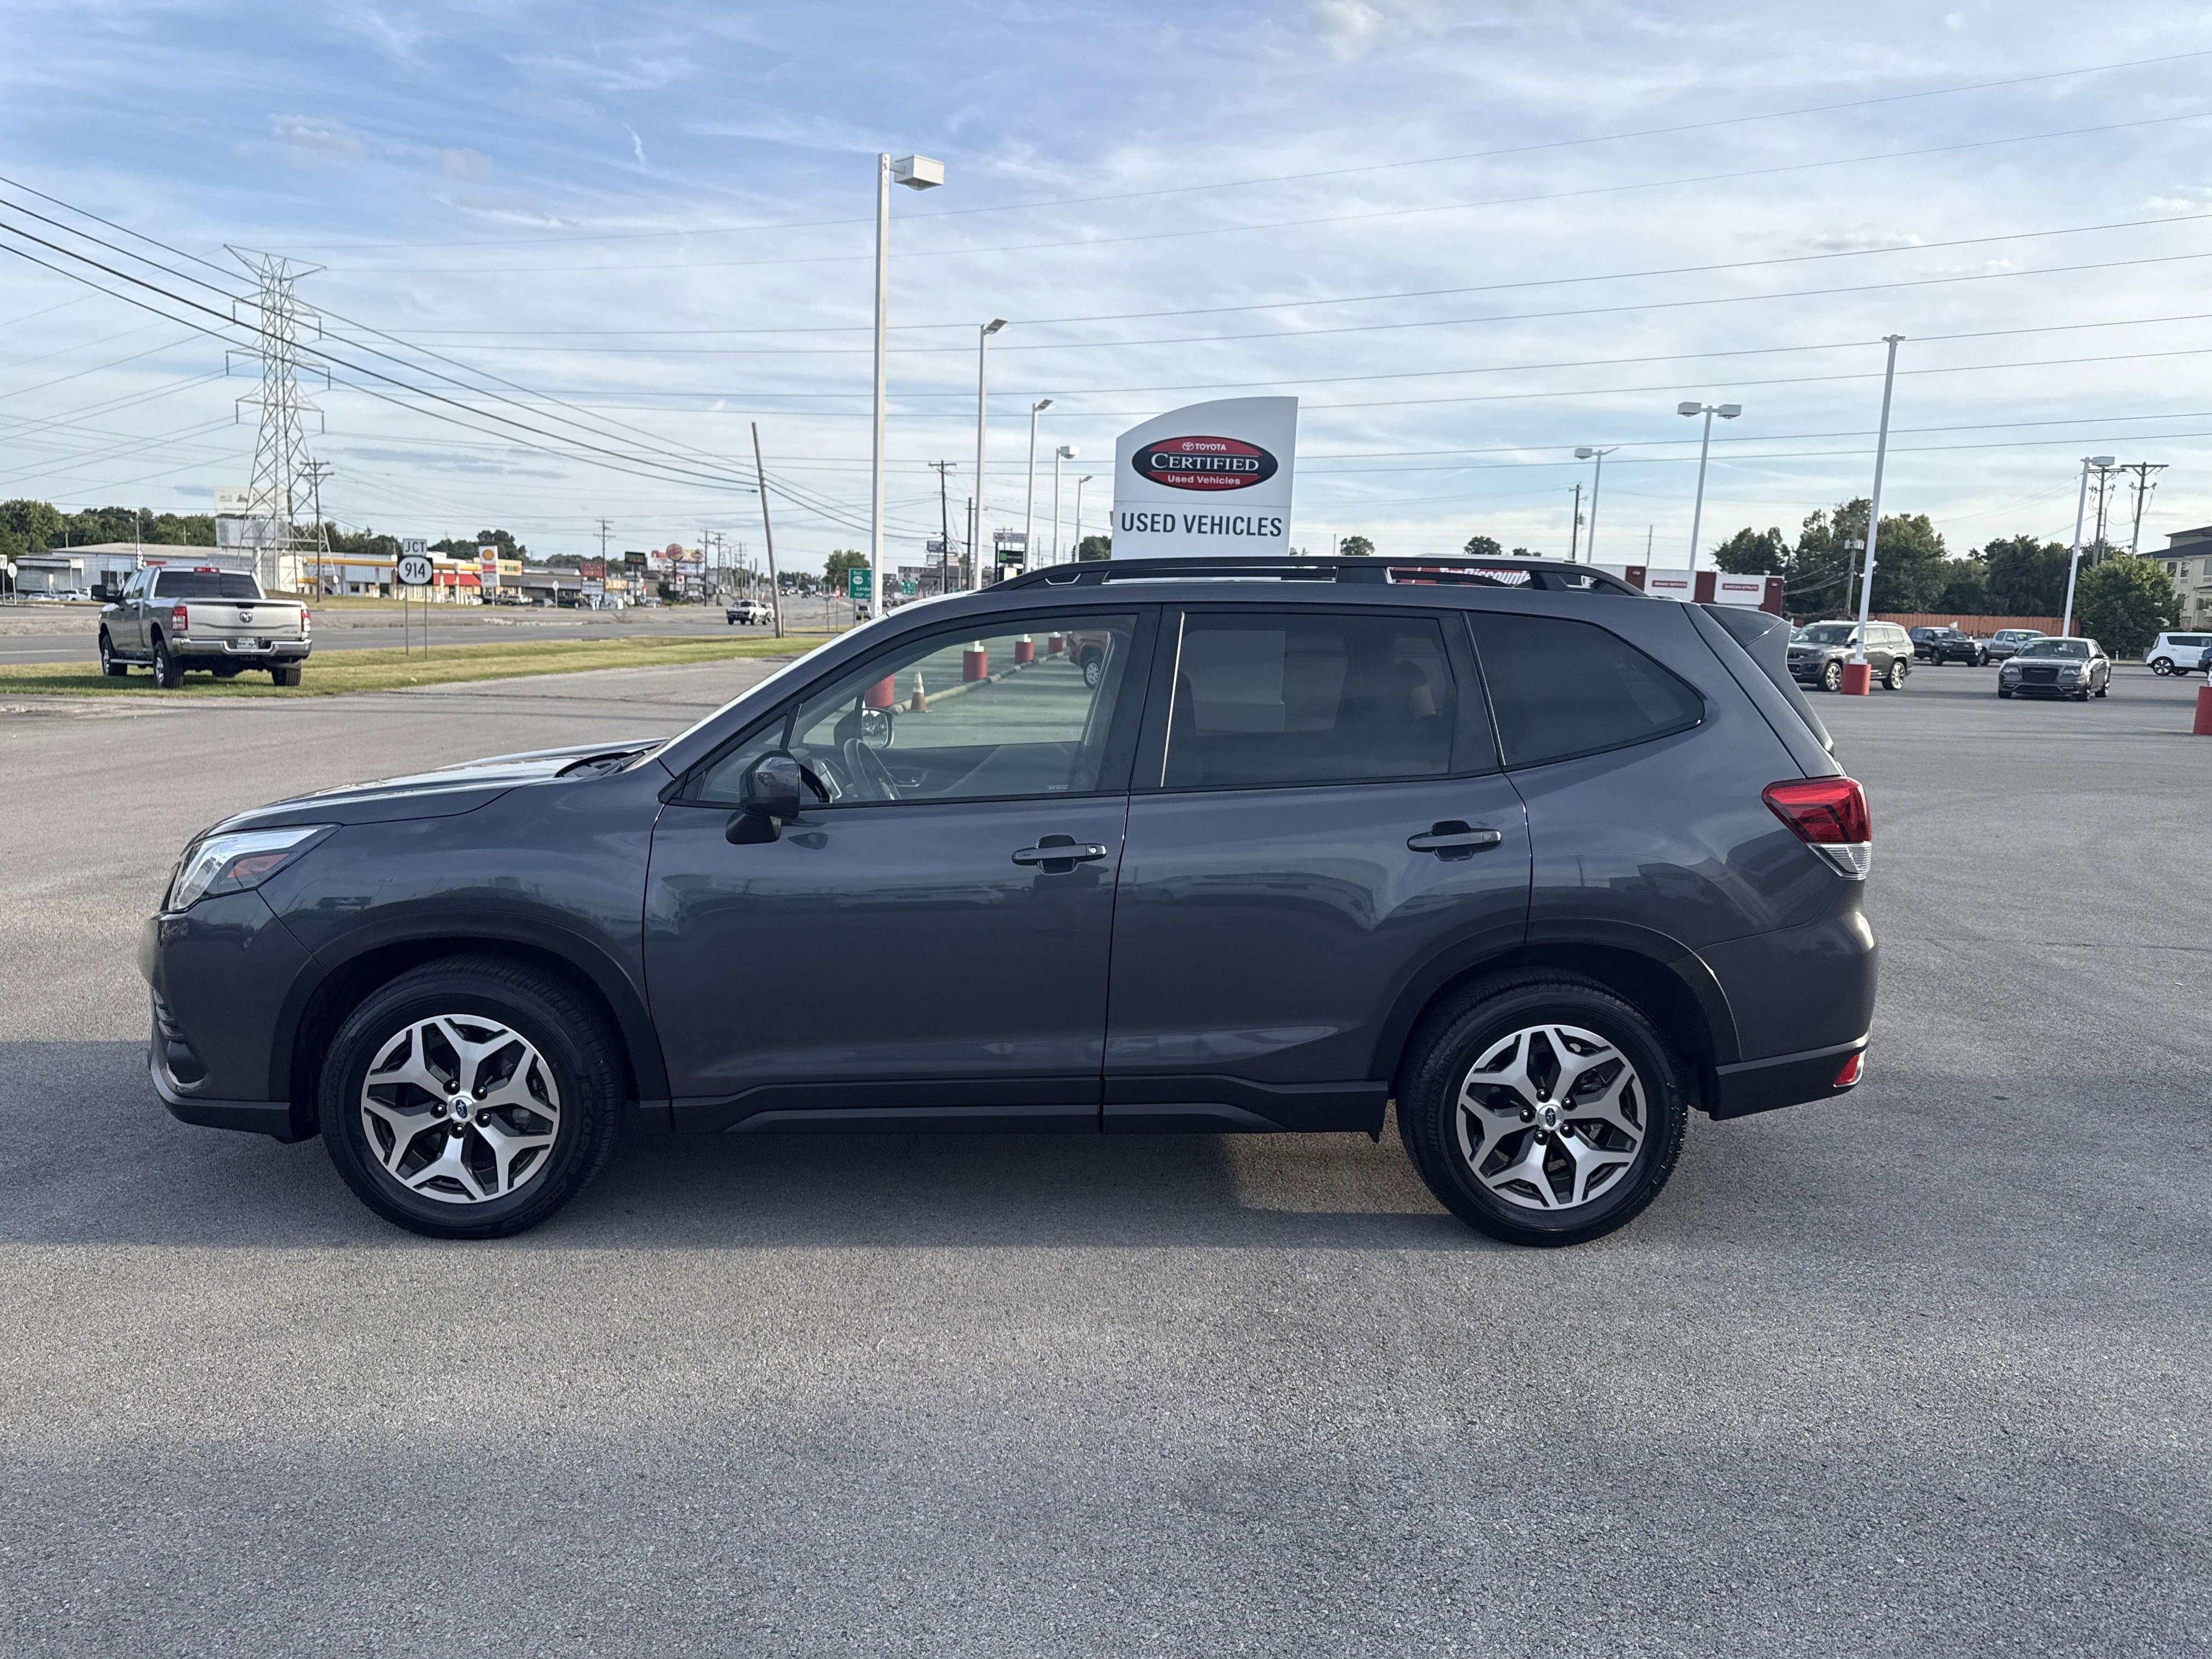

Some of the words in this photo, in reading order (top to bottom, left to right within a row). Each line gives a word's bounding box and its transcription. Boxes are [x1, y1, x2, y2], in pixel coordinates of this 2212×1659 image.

[1195, 443, 1227, 451] TOYOTA
[1151, 453, 1259, 471] CERTIFIED
[1167, 475, 1194, 483] Used
[1197, 476, 1241, 485] Vehicles
[1121, 512, 1176, 533] USED
[1183, 515, 1282, 537] VEHICLES
[405, 541, 426, 552] JCT
[405, 562, 426, 578] 914
